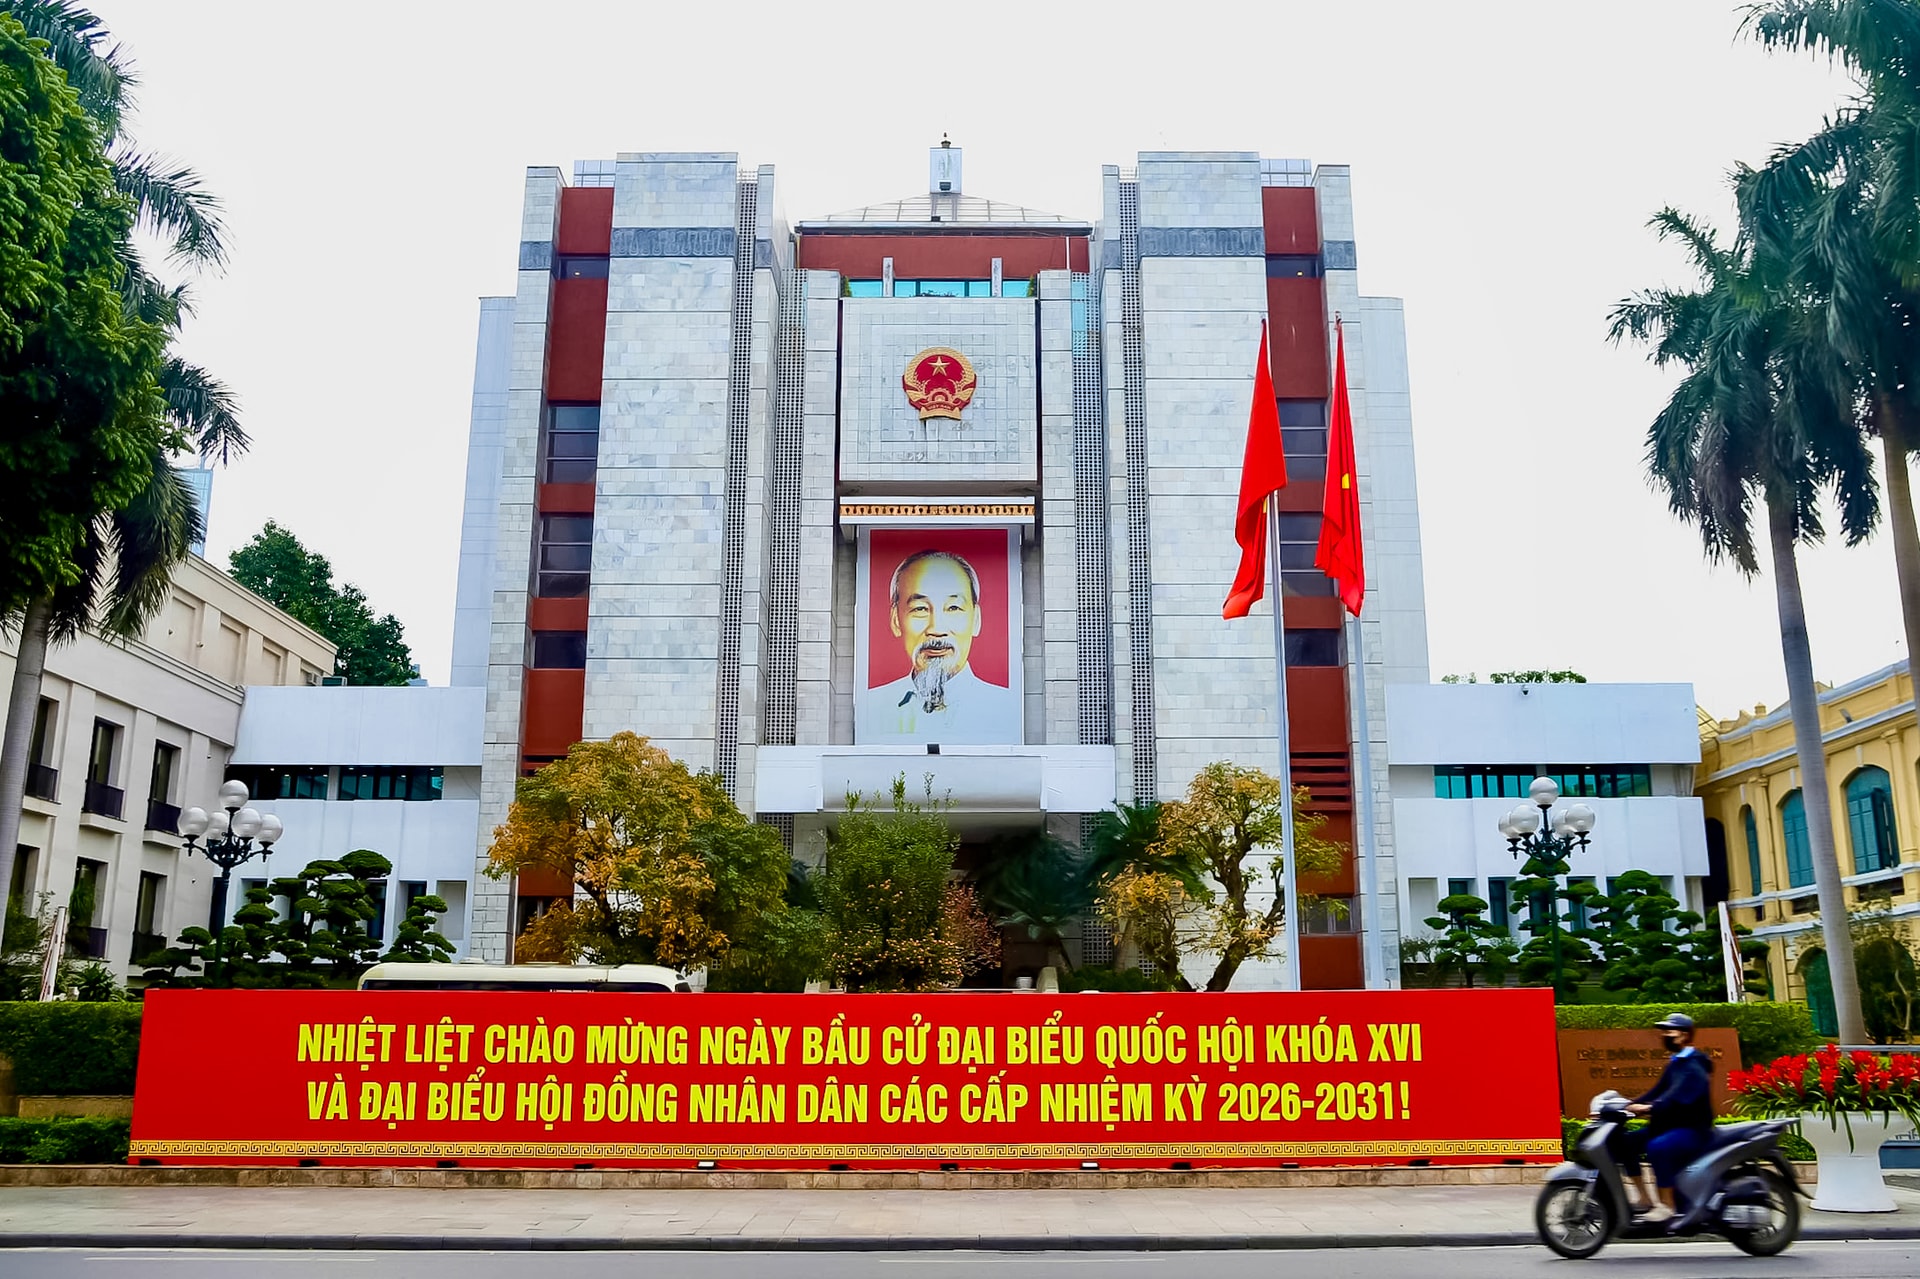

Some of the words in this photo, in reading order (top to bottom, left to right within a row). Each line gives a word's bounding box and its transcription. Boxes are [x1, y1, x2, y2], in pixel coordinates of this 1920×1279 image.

[297, 1015, 397, 1072] NHIỆT
[405, 1016, 475, 1072] LIỆT
[484, 1016, 575, 1064] CHÀO
[585, 1016, 688, 1065] MỪNG
[699, 1017, 792, 1065] NGÀY
[802, 1012, 871, 1066] BẦU
[882, 1012, 931, 1066] CỬ
[935, 1026, 995, 1074] ĐẠI
[1006, 1009, 1084, 1065] BIỂU
[1095, 1011, 1187, 1069] QUỐC
[1197, 1016, 1255, 1073] HỘI
[1265, 1015, 1359, 1063] KHÓA
[1366, 1023, 1423, 1062] XVI
[307, 1072, 349, 1120] VÀ
[359, 1081, 417, 1130] ĐẠI
[426, 1065, 506, 1122] BIỂU
[515, 1074, 573, 1131] HỘI
[582, 1069, 678, 1123] ĐỒNG
[689, 1075, 786, 1123] NHÂN
[797, 1075, 868, 1123] DÂN
[879, 1075, 948, 1124] CÁC
[959, 1069, 1029, 1124] CẤP
[1040, 1074, 1153, 1132] NHIỆM
[1164, 1074, 1208, 1122] KỲ
[1218, 1080, 1411, 1122] 2026-2031!
